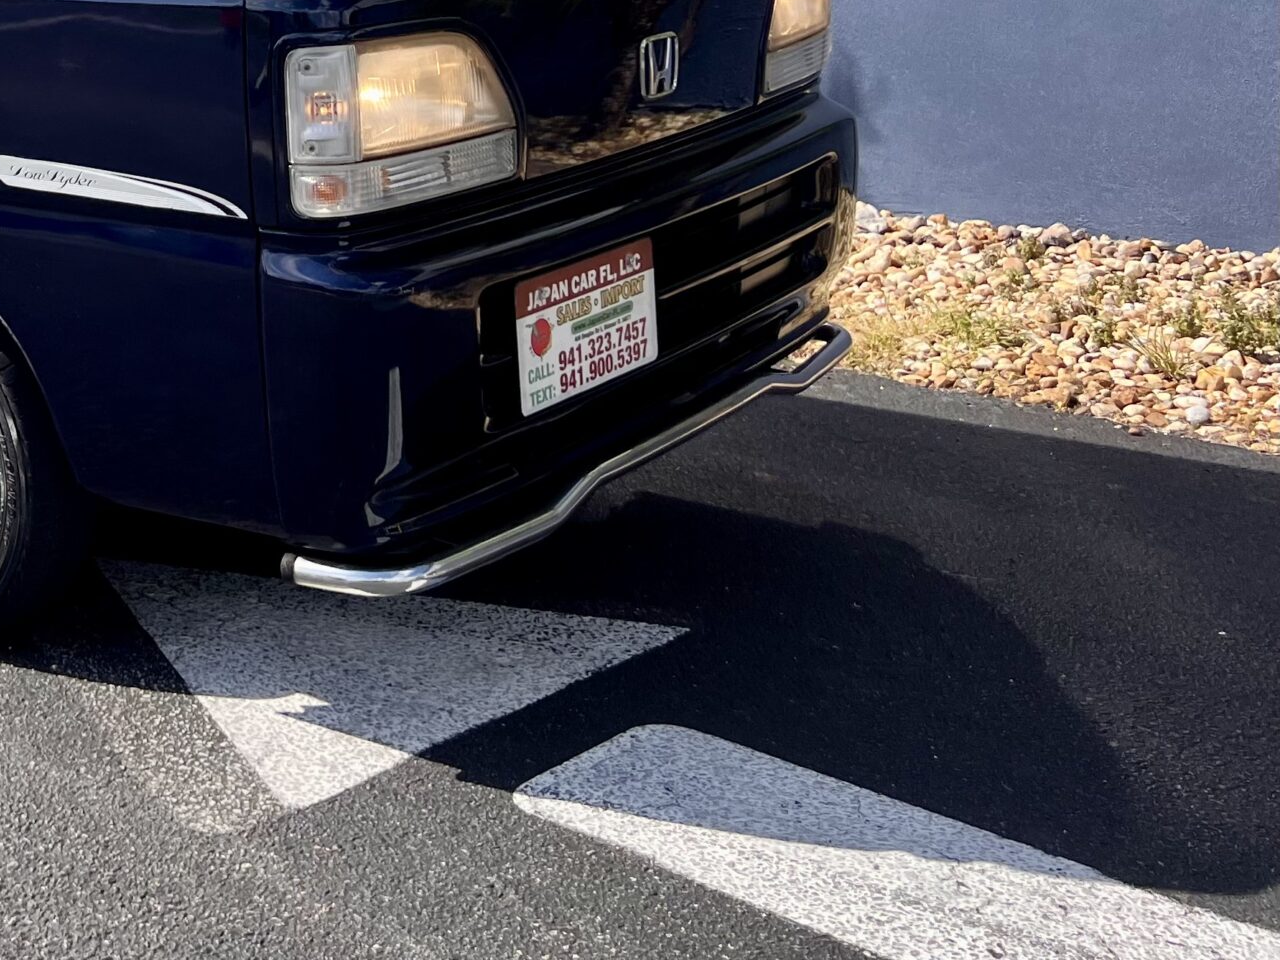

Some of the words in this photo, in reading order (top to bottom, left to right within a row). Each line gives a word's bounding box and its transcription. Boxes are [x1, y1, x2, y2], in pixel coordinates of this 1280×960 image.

[556, 295, 593, 326] SALES
[600, 275, 646, 309] IMPORT
[571, 269, 597, 295] CAR
[599, 263, 618, 283] FL,
[528, 363, 555, 385] CALL:
[558, 316, 647, 371] 941.323.7457
[530, 385, 557, 408] TEXT:
[560, 340, 648, 394] 941.900.5397
